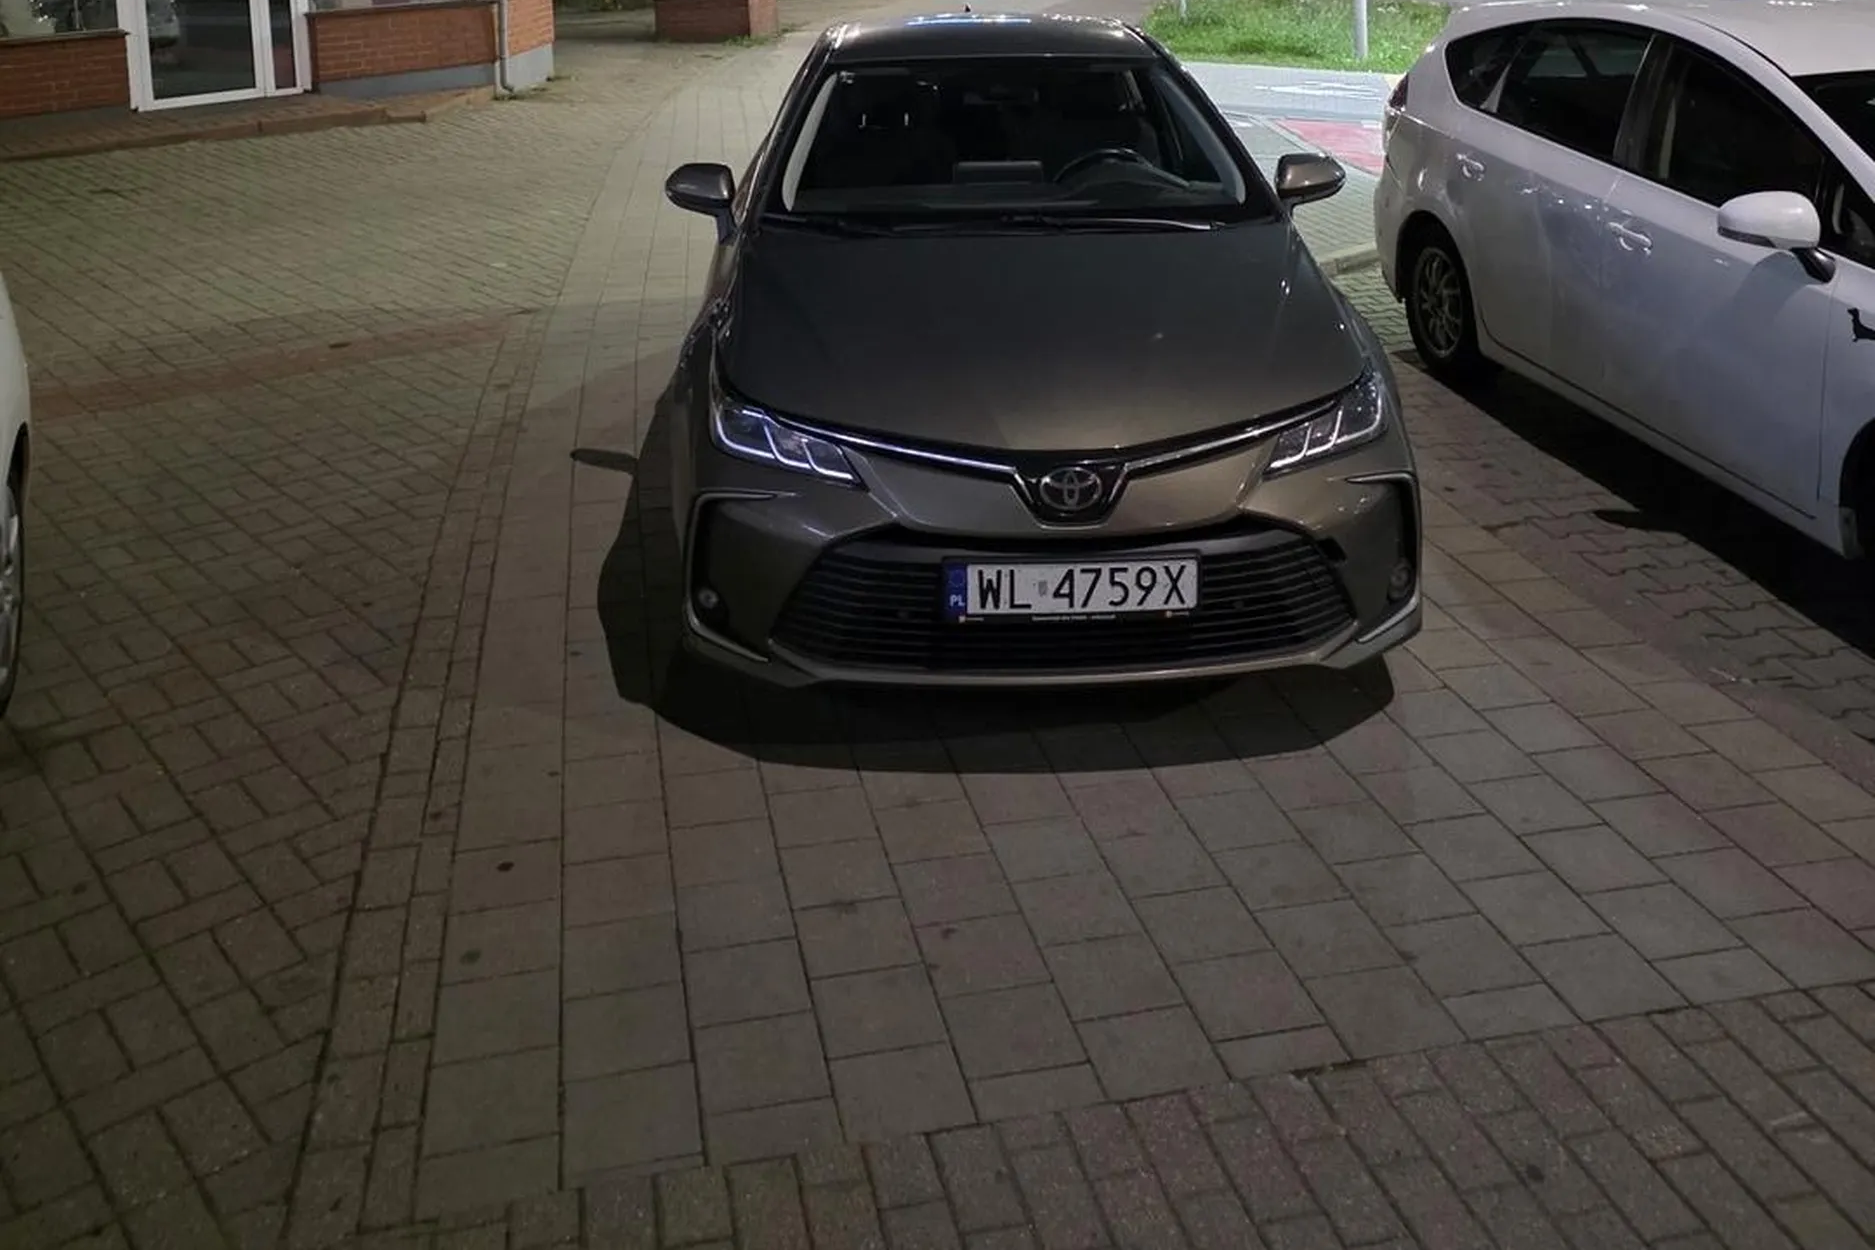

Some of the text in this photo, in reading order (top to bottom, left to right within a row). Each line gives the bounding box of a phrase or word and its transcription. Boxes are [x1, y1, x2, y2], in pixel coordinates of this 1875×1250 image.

[950, 594, 965, 607] PL
[977, 564, 1187, 610] WL 4759X
